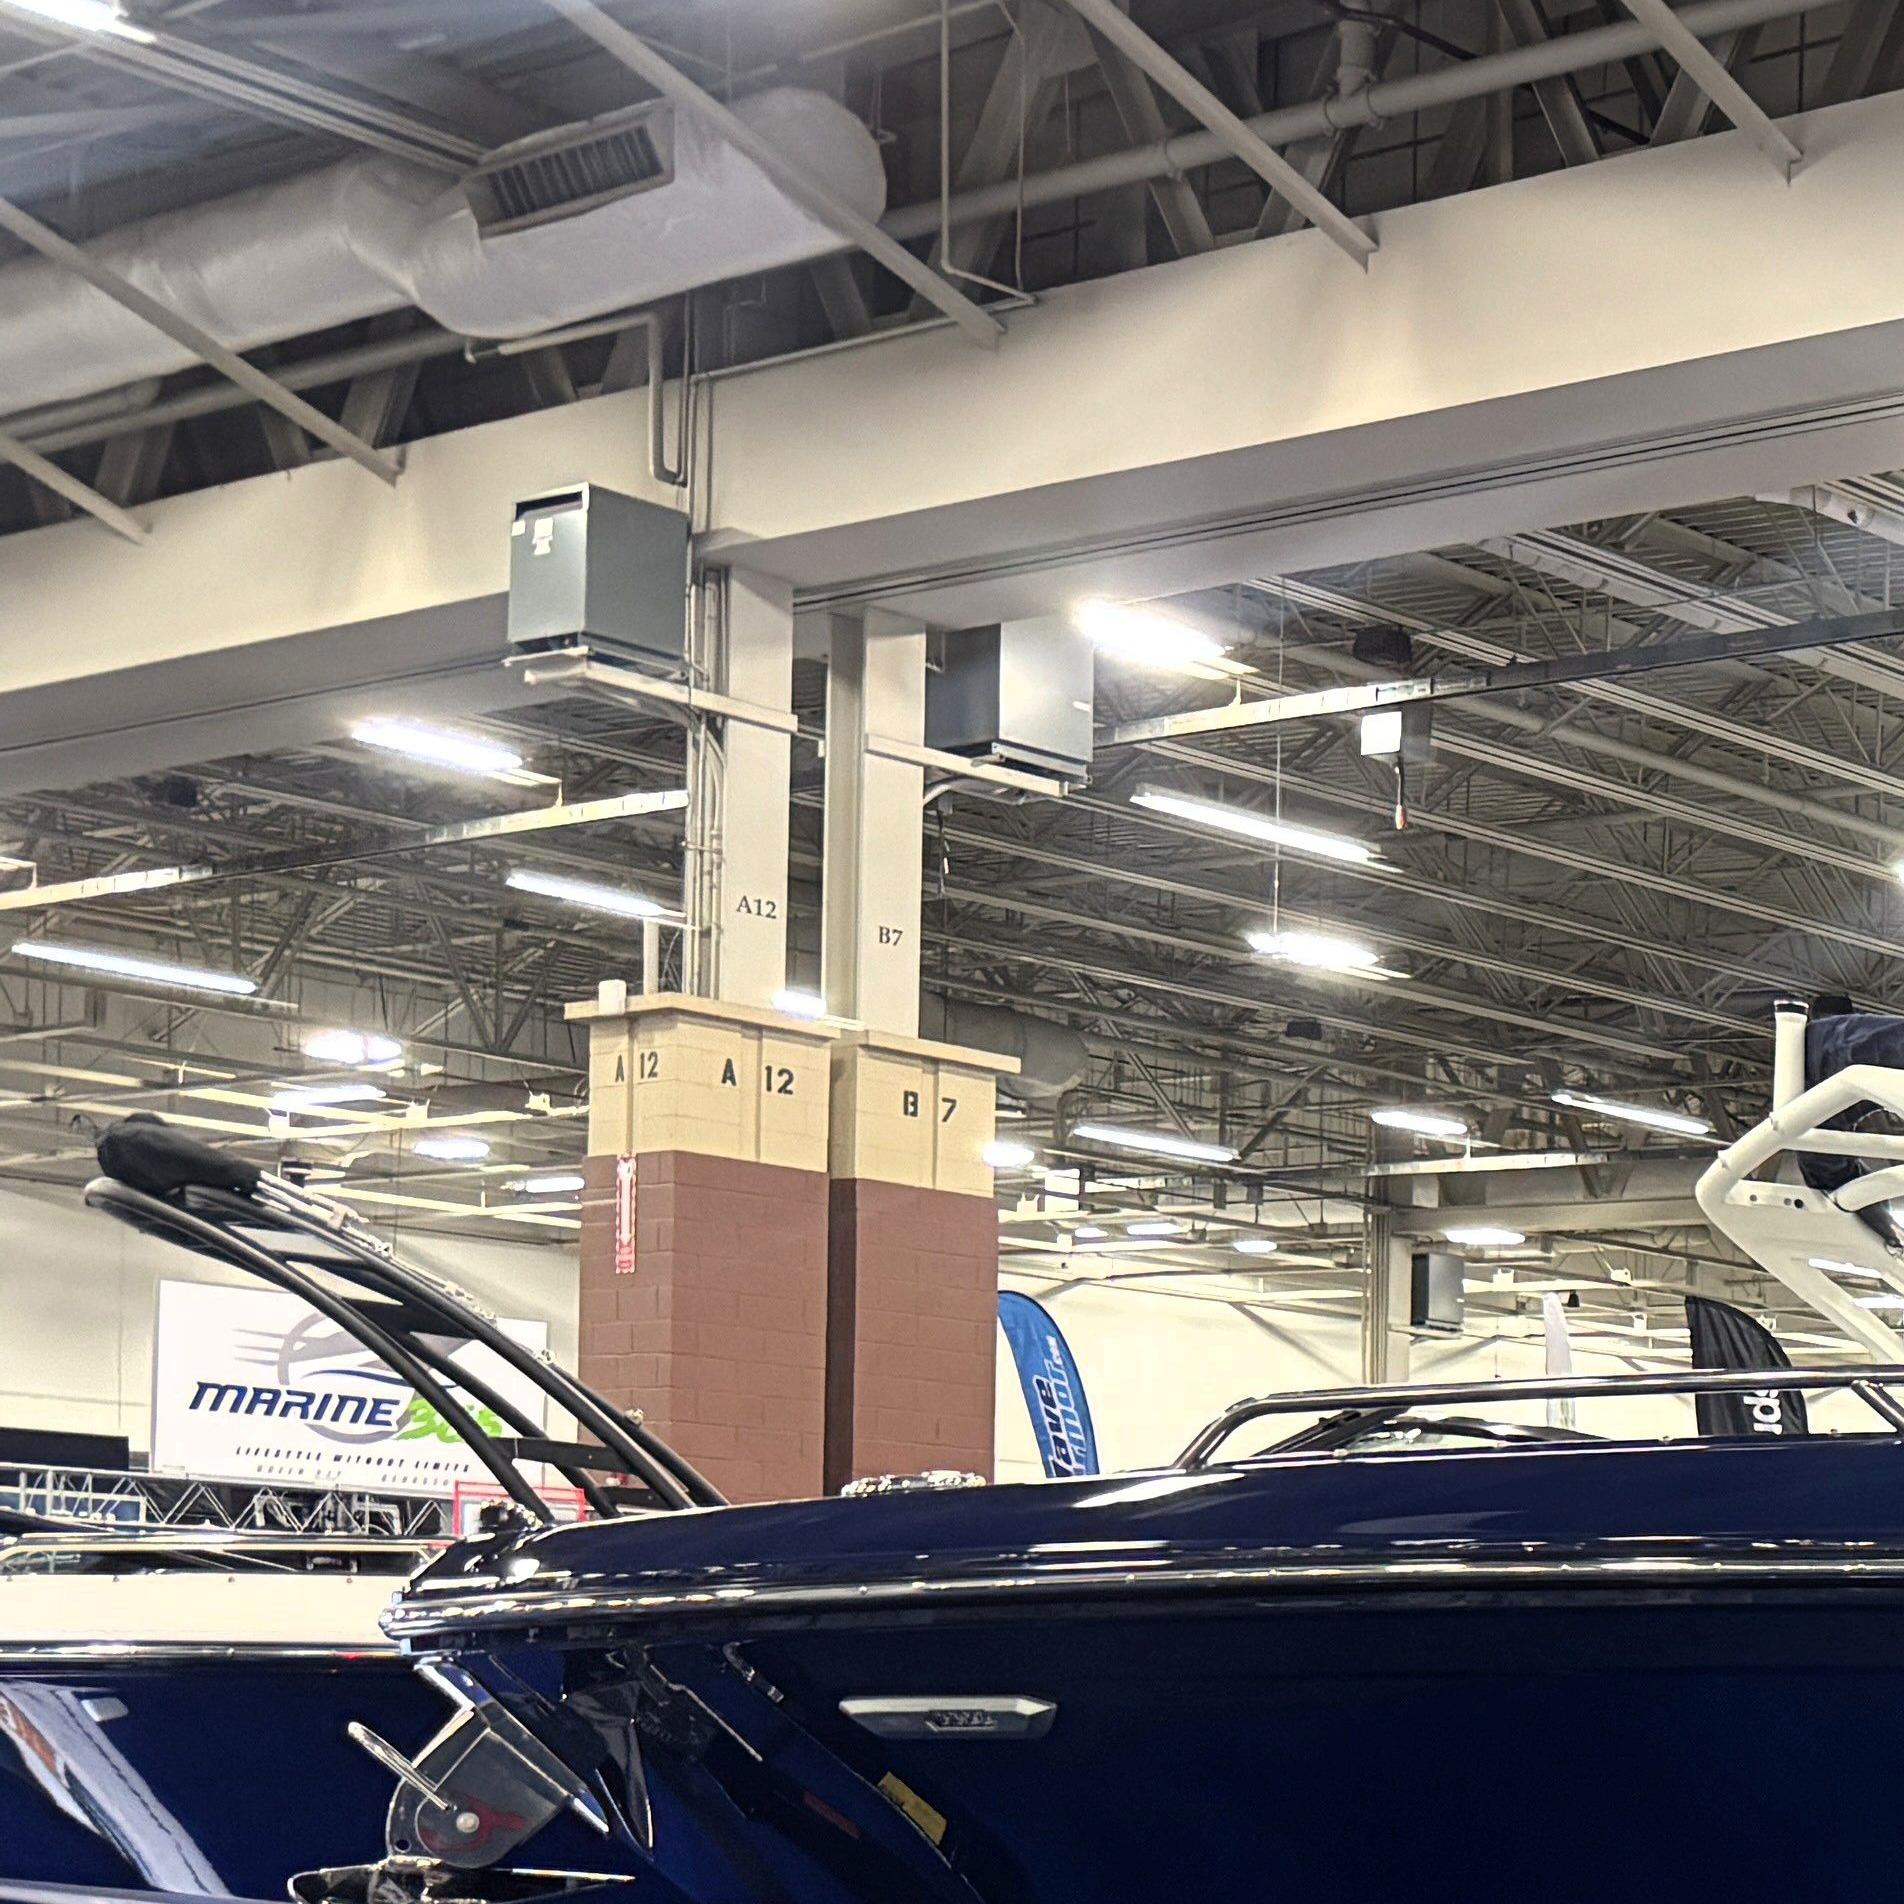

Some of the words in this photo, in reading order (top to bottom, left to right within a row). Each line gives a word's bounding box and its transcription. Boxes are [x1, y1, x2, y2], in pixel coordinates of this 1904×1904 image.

[736, 894, 778, 919] A12
[878, 925, 903, 946] B7
[640, 1051, 659, 1080] 12
[721, 1057, 737, 1087] A
[765, 1065, 795, 1096] 12
[903, 1090, 918, 1118] B
[941, 1097, 958, 1123] 7
[189, 1381, 401, 1427] MARINE
